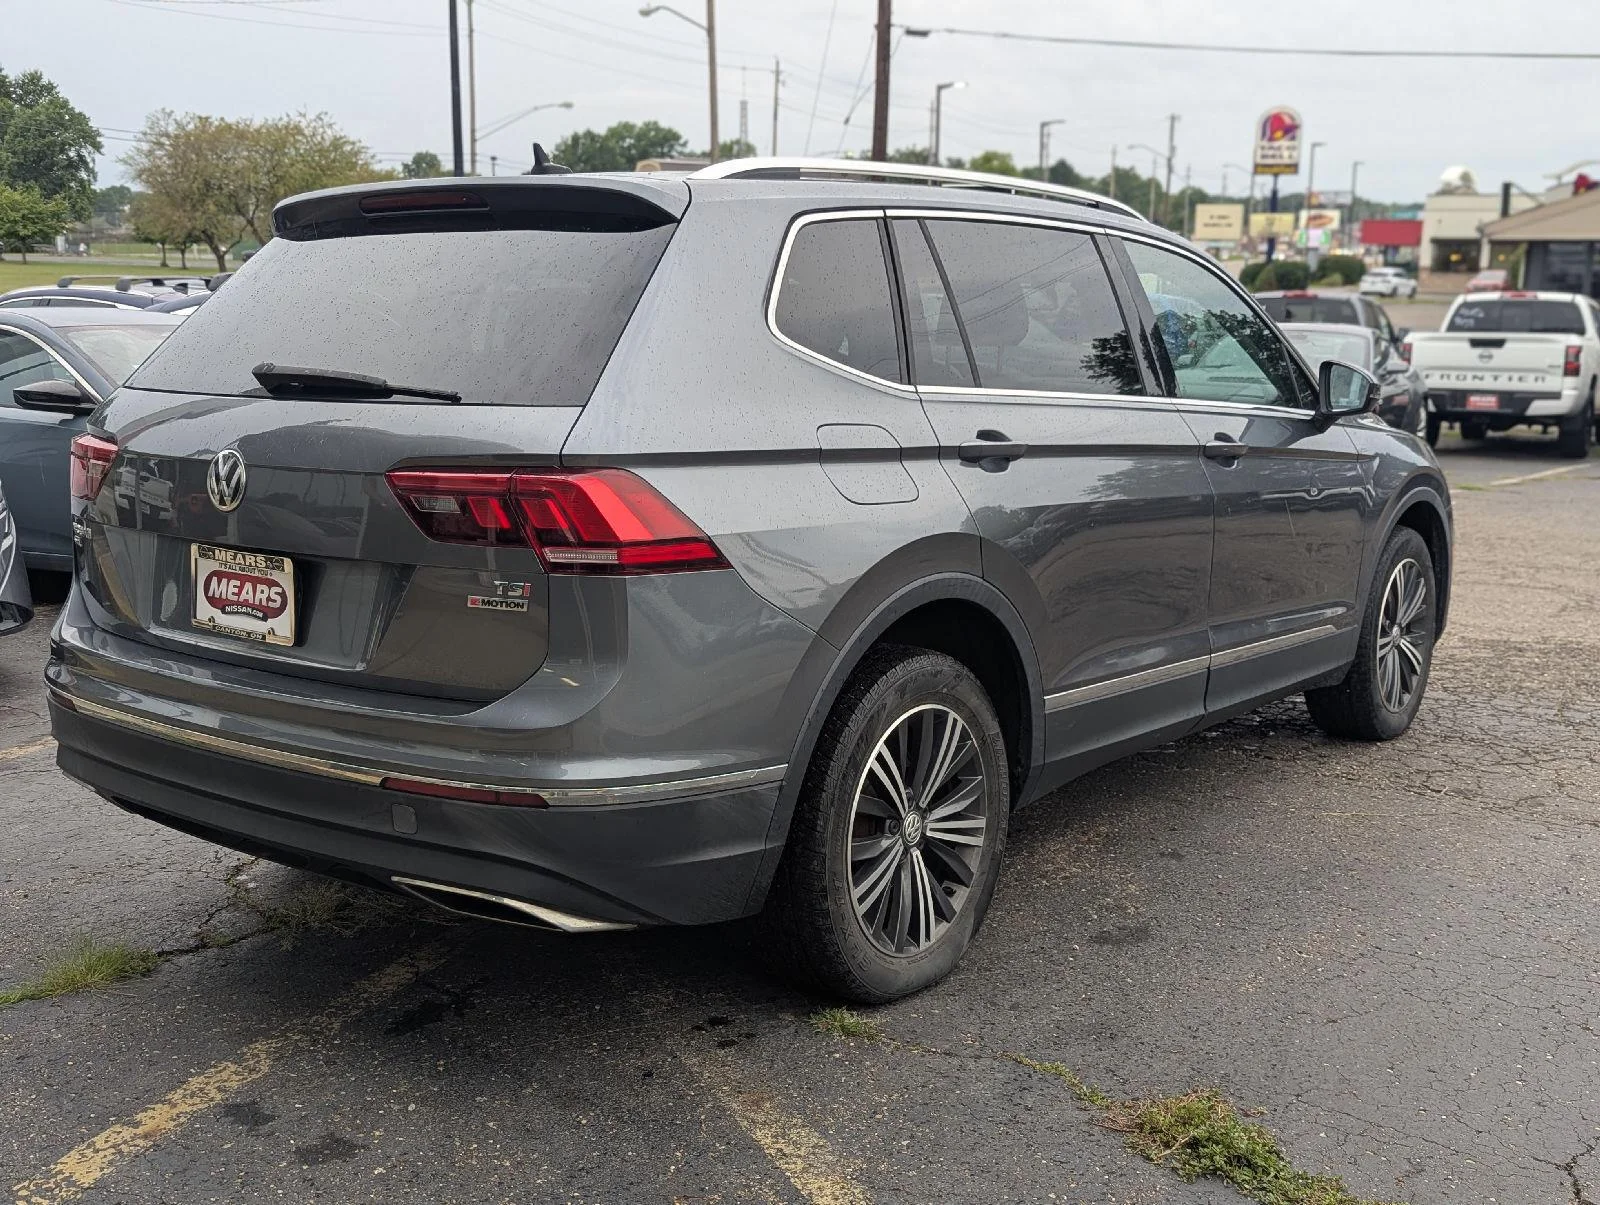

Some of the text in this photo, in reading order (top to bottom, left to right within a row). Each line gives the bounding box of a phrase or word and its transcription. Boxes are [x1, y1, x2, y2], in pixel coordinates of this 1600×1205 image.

[1424, 373, 1547, 384] FRONTIER
[214, 548, 266, 568] MEARS
[228, 563, 238, 572] ALL
[238, 565, 256, 575] ABOUT
[257, 568, 269, 577] YOU
[208, 576, 283, 609] MEARS
